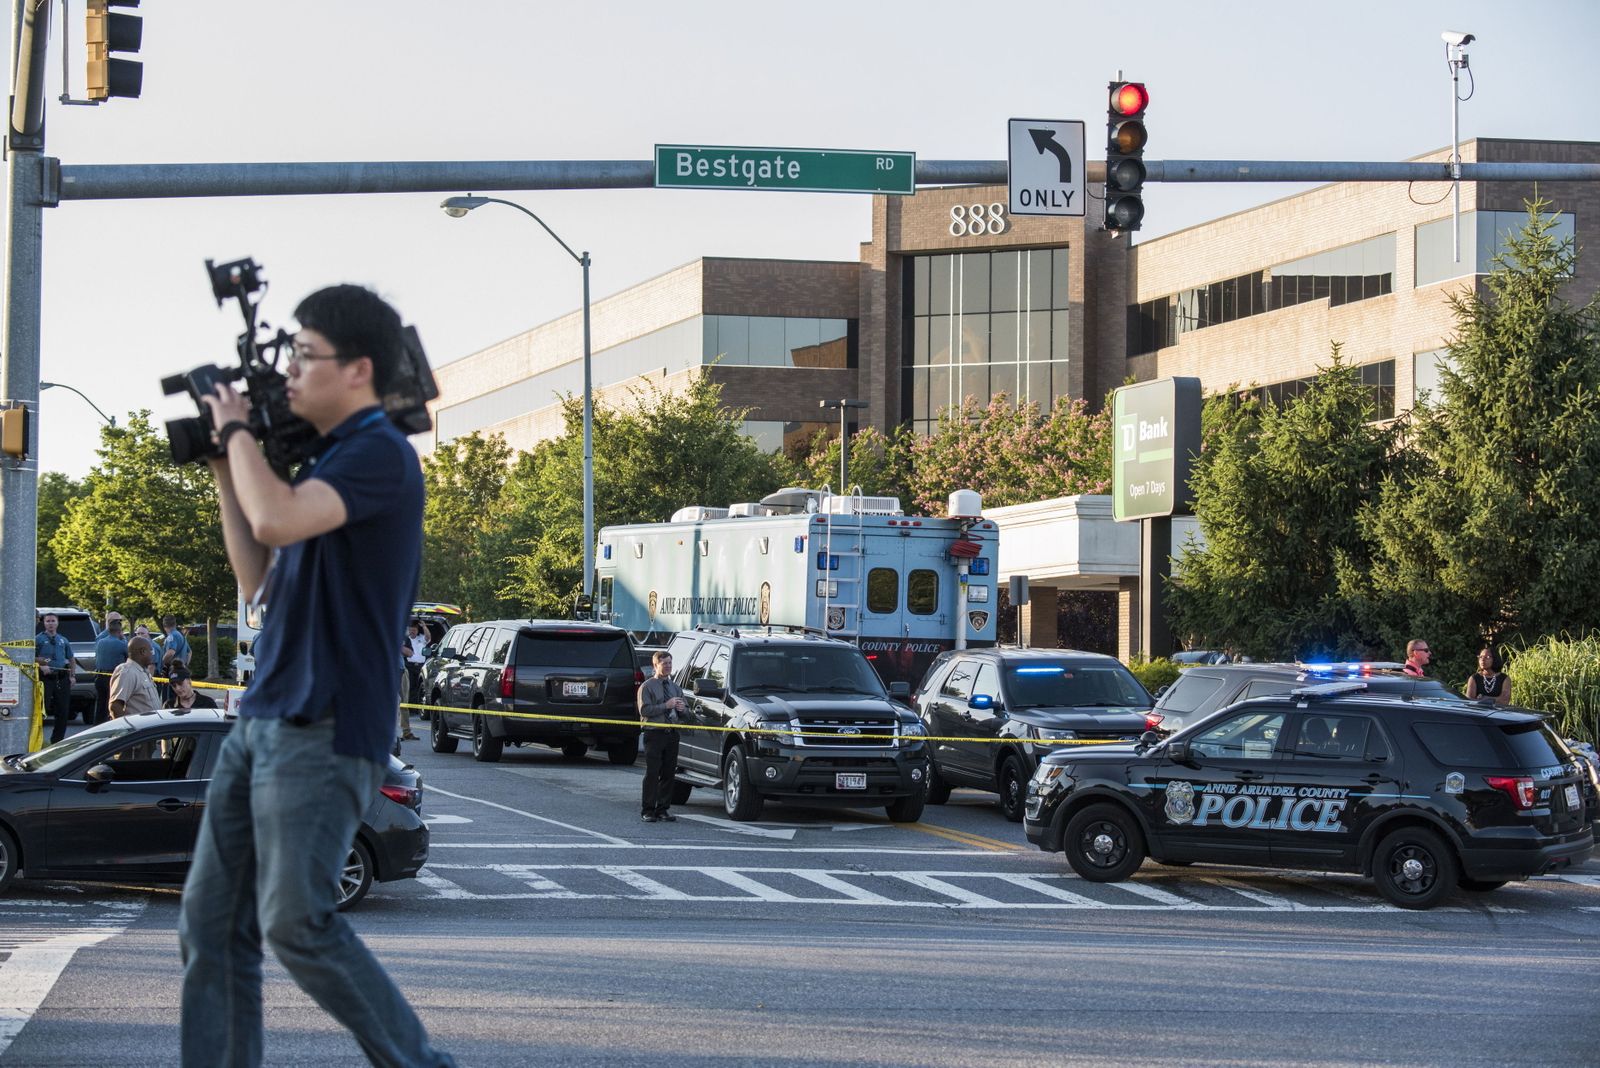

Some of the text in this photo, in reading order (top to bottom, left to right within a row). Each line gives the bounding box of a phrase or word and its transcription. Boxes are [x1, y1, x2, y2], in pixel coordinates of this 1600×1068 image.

[676, 152, 895, 186] Bestgate RD
[1020, 188, 1075, 208] ONLY
[949, 202, 1005, 237] 888
[1120, 416, 1168, 452] TD Bank
[1130, 481, 1165, 499] Open 7 Days
[660, 597, 757, 615] ANNE ARUNDEL COUNTY POLICE
[861, 641, 901, 651] COUNTY
[905, 643, 941, 653] POLICE
[1202, 783, 1350, 799] ANNE ARUNDEL COUNTY
[1191, 794, 1348, 833] POLICE
